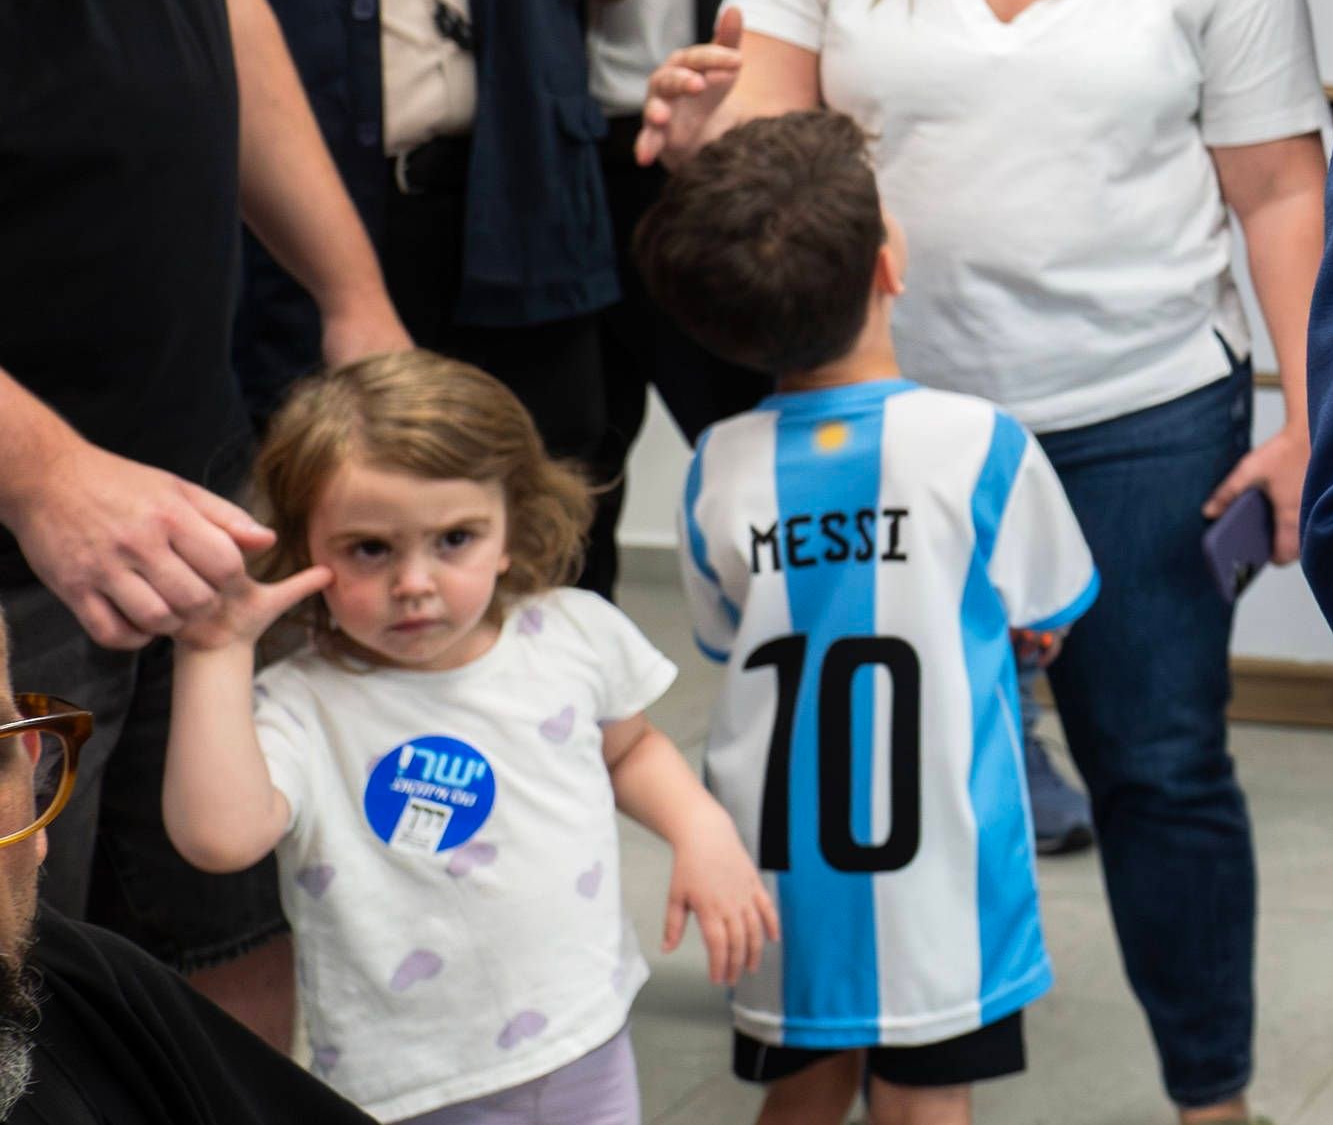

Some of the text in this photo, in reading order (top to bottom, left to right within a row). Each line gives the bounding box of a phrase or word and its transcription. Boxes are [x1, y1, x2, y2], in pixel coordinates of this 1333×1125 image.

[749, 509, 908, 574] MESSI
[397, 744, 486, 788] ישר!
[743, 635, 921, 873] 10
